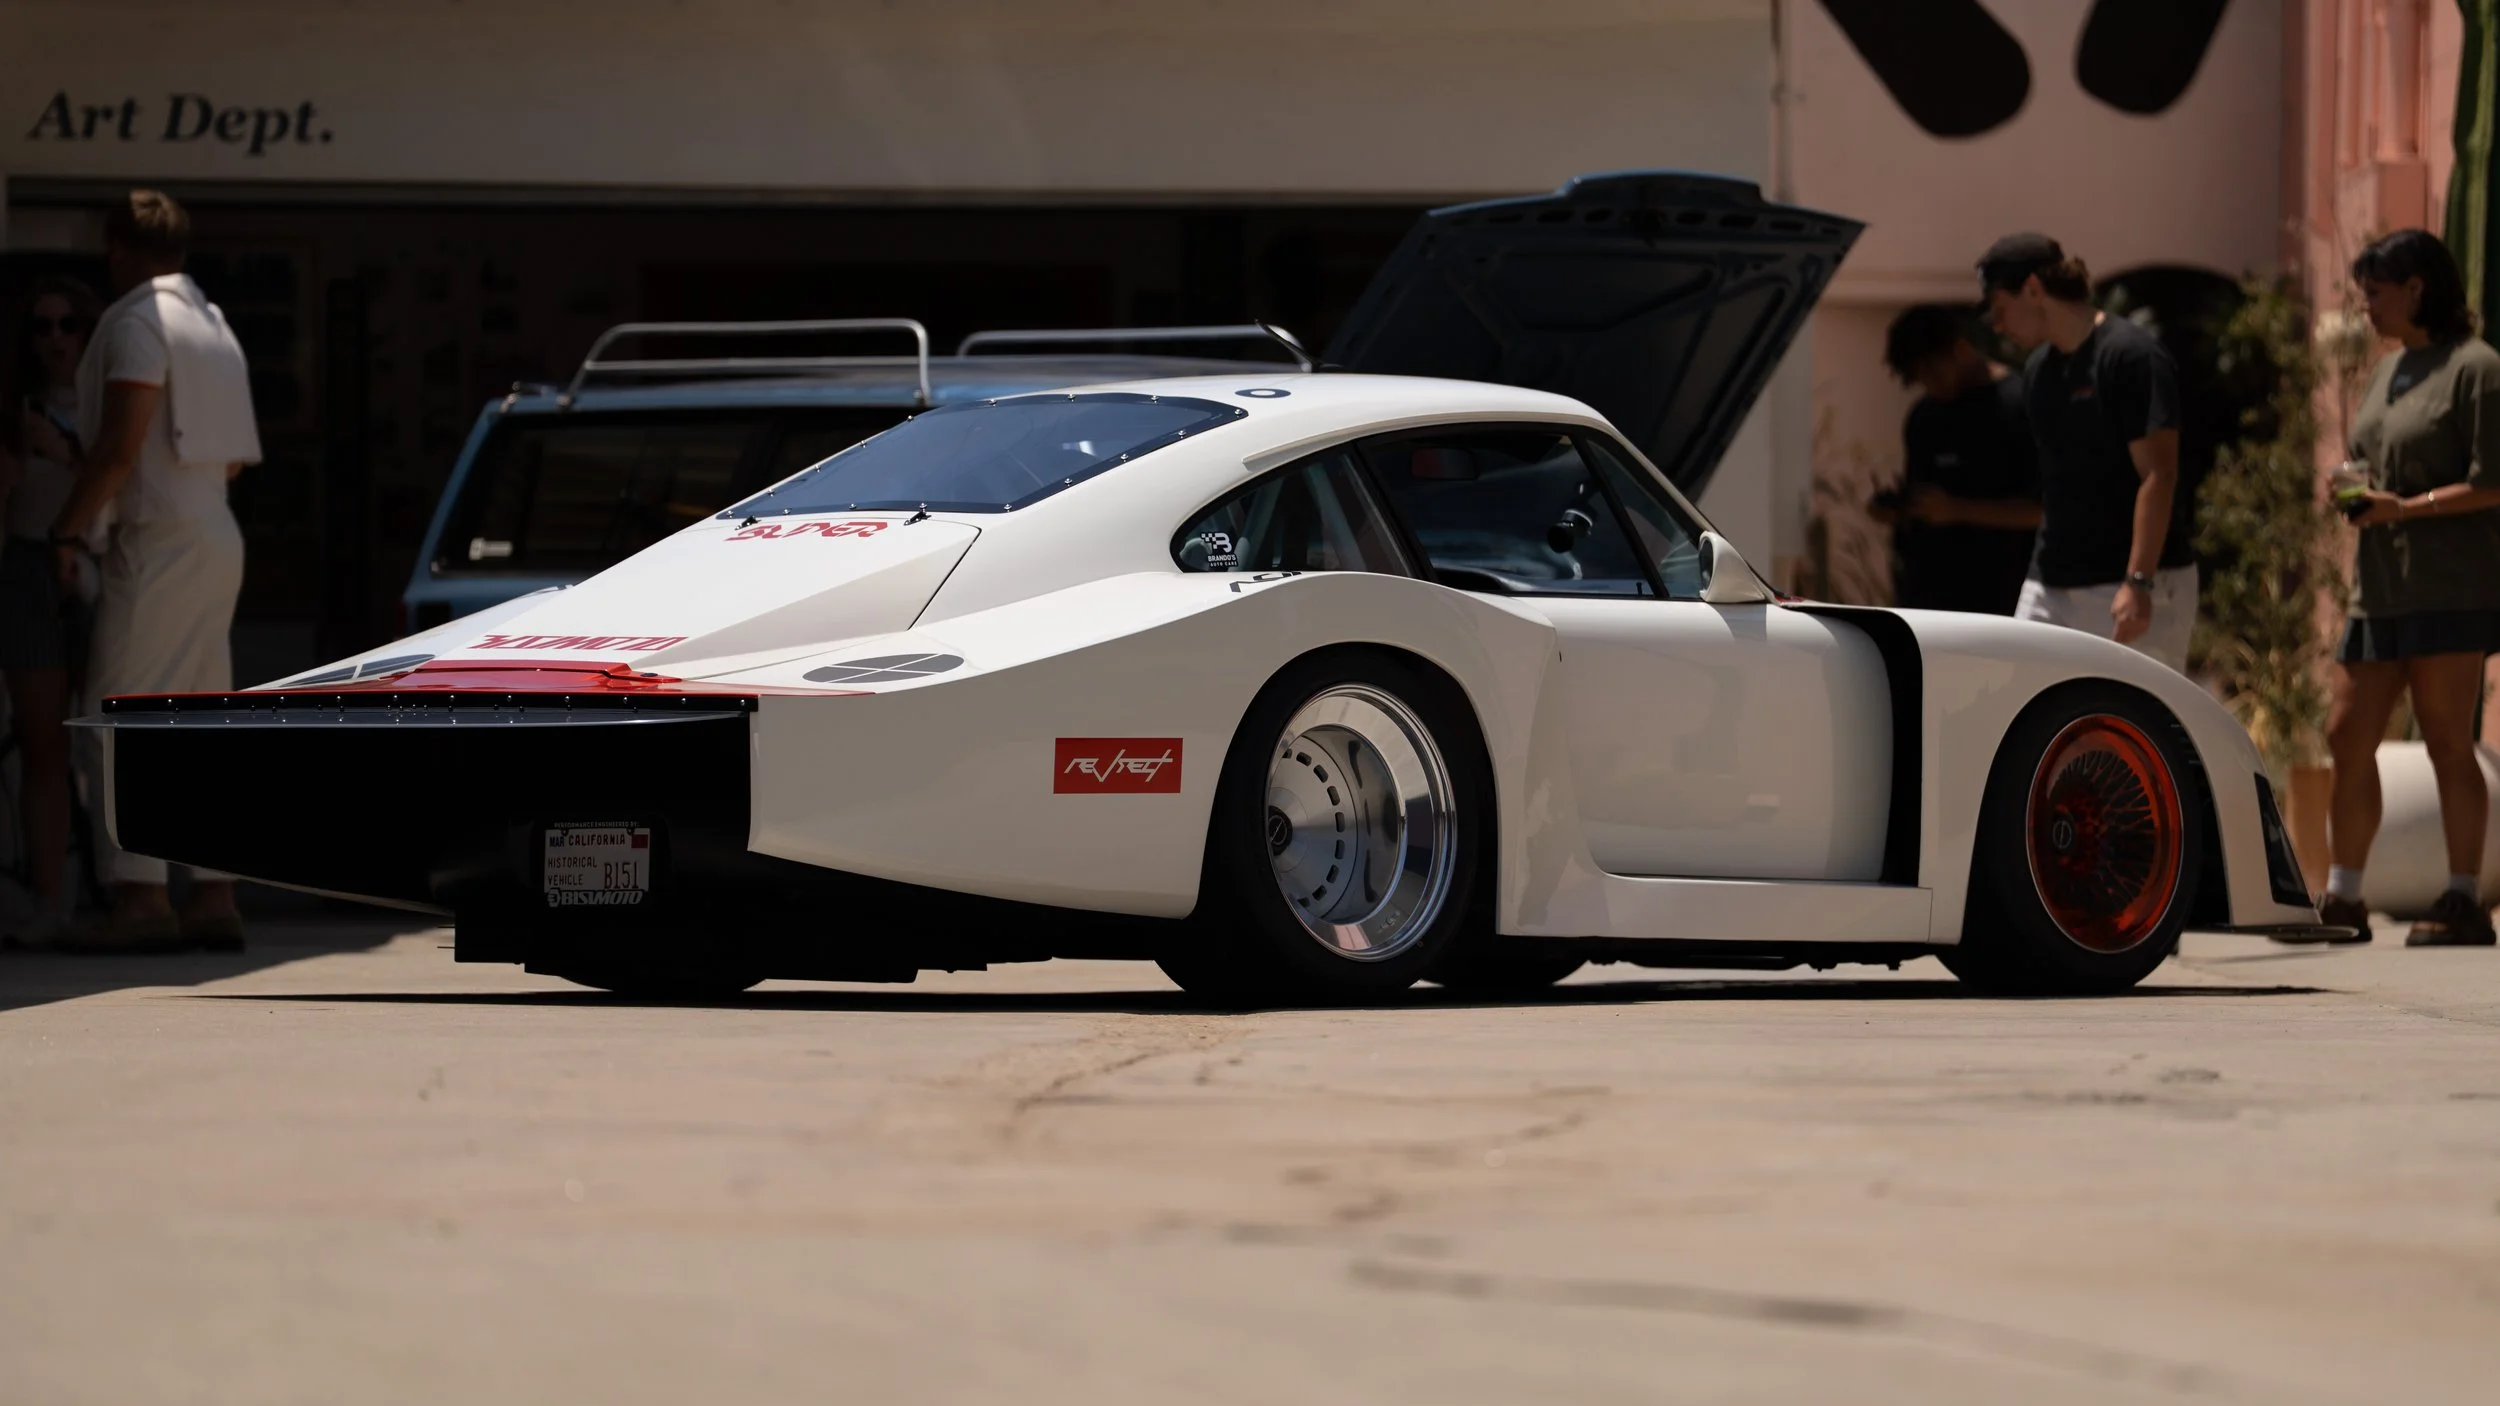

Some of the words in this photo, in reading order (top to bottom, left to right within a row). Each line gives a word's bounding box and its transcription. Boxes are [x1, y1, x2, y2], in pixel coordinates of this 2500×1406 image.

[26, 90, 141, 143] Art
[161, 92, 334, 157] Dept.
[724, 521, 888, 541] SUPER
[549, 836, 565, 848] MAR
[568, 834, 626, 846] CALIFORNIA
[548, 856, 597, 869] HISTORICAL
[547, 874, 583, 886] VEHICLE
[604, 861, 639, 889] B151
[561, 890, 643, 905] BISIMOTO
